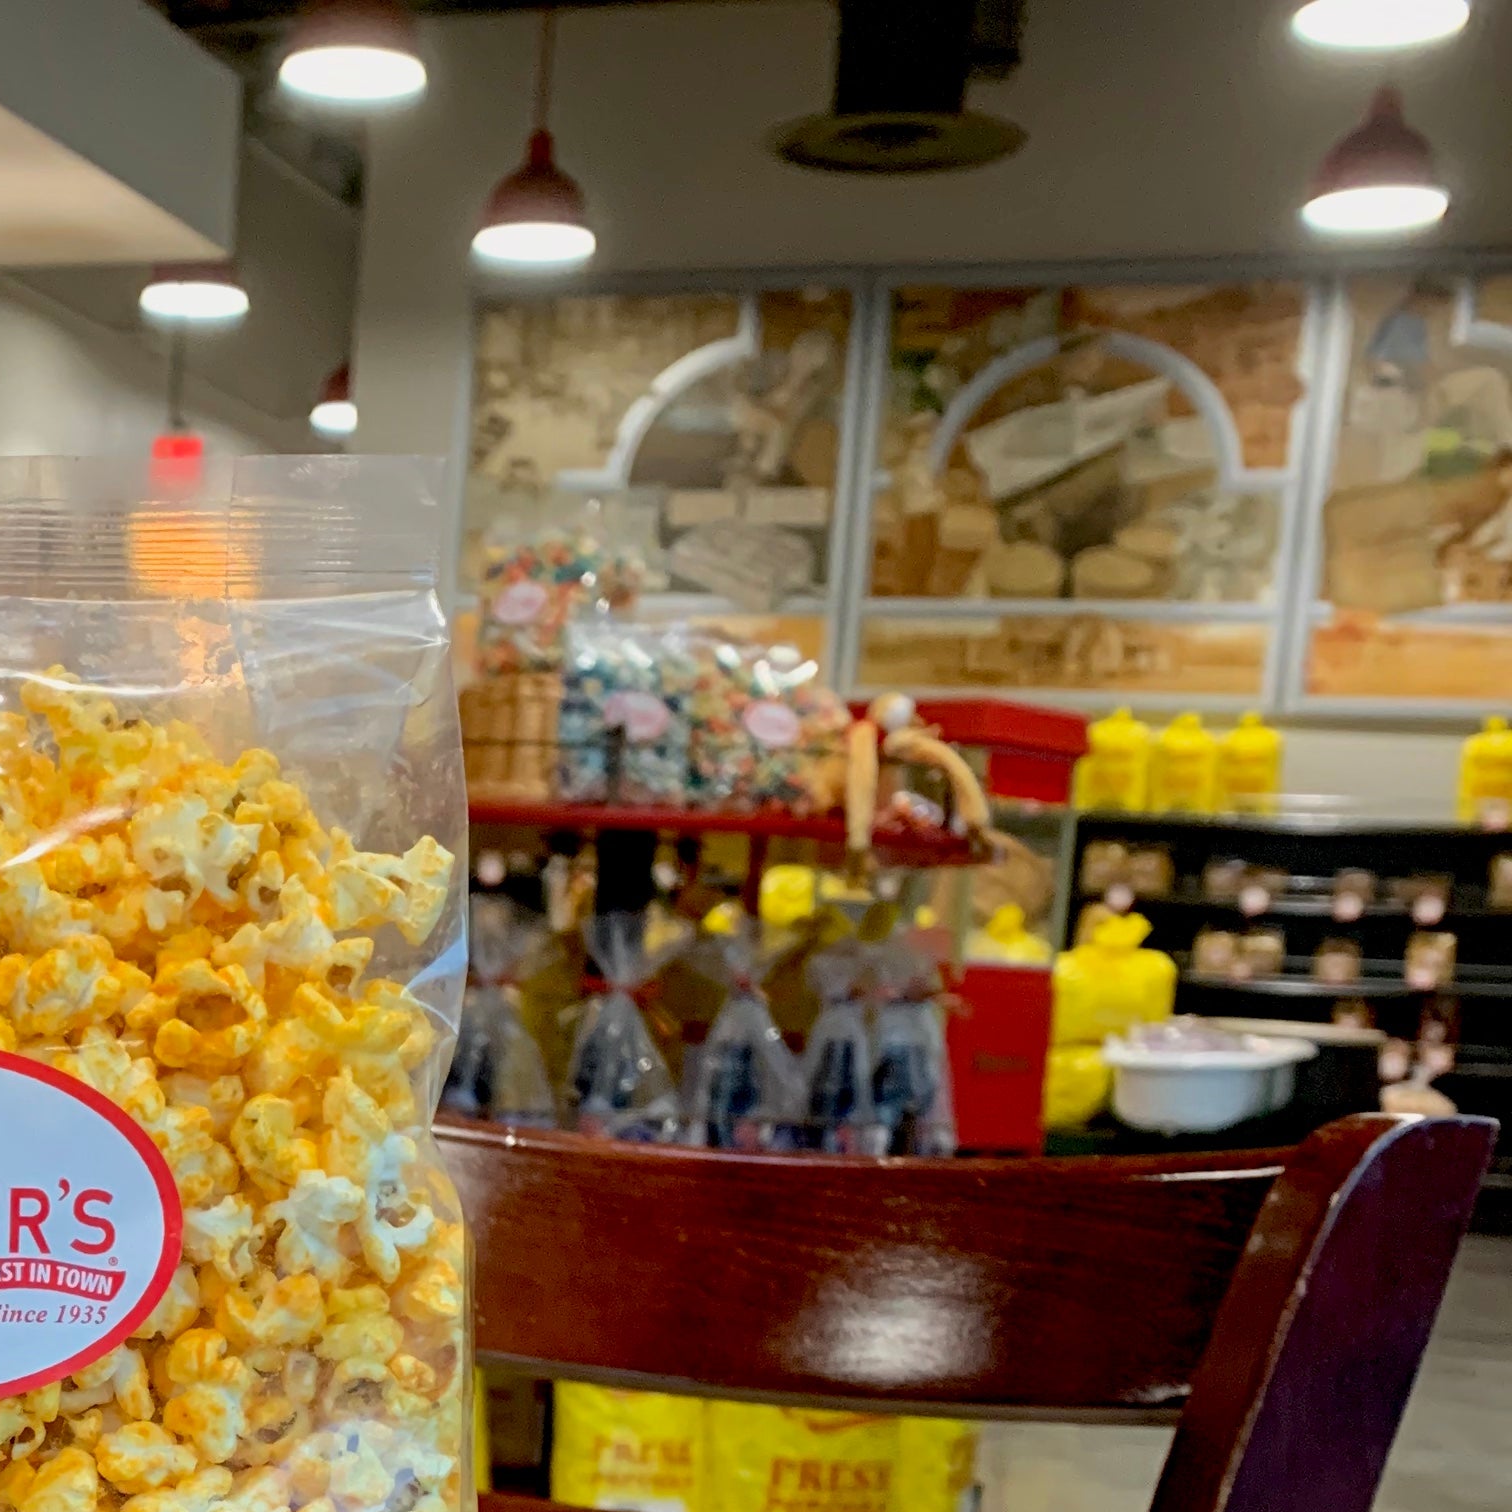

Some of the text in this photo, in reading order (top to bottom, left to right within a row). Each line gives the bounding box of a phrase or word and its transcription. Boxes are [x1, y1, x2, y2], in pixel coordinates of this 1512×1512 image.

[29, 1262, 51, 1284] IN
[56, 1266, 113, 1297] TOWN
[54, 1304, 109, 1326] 1935
